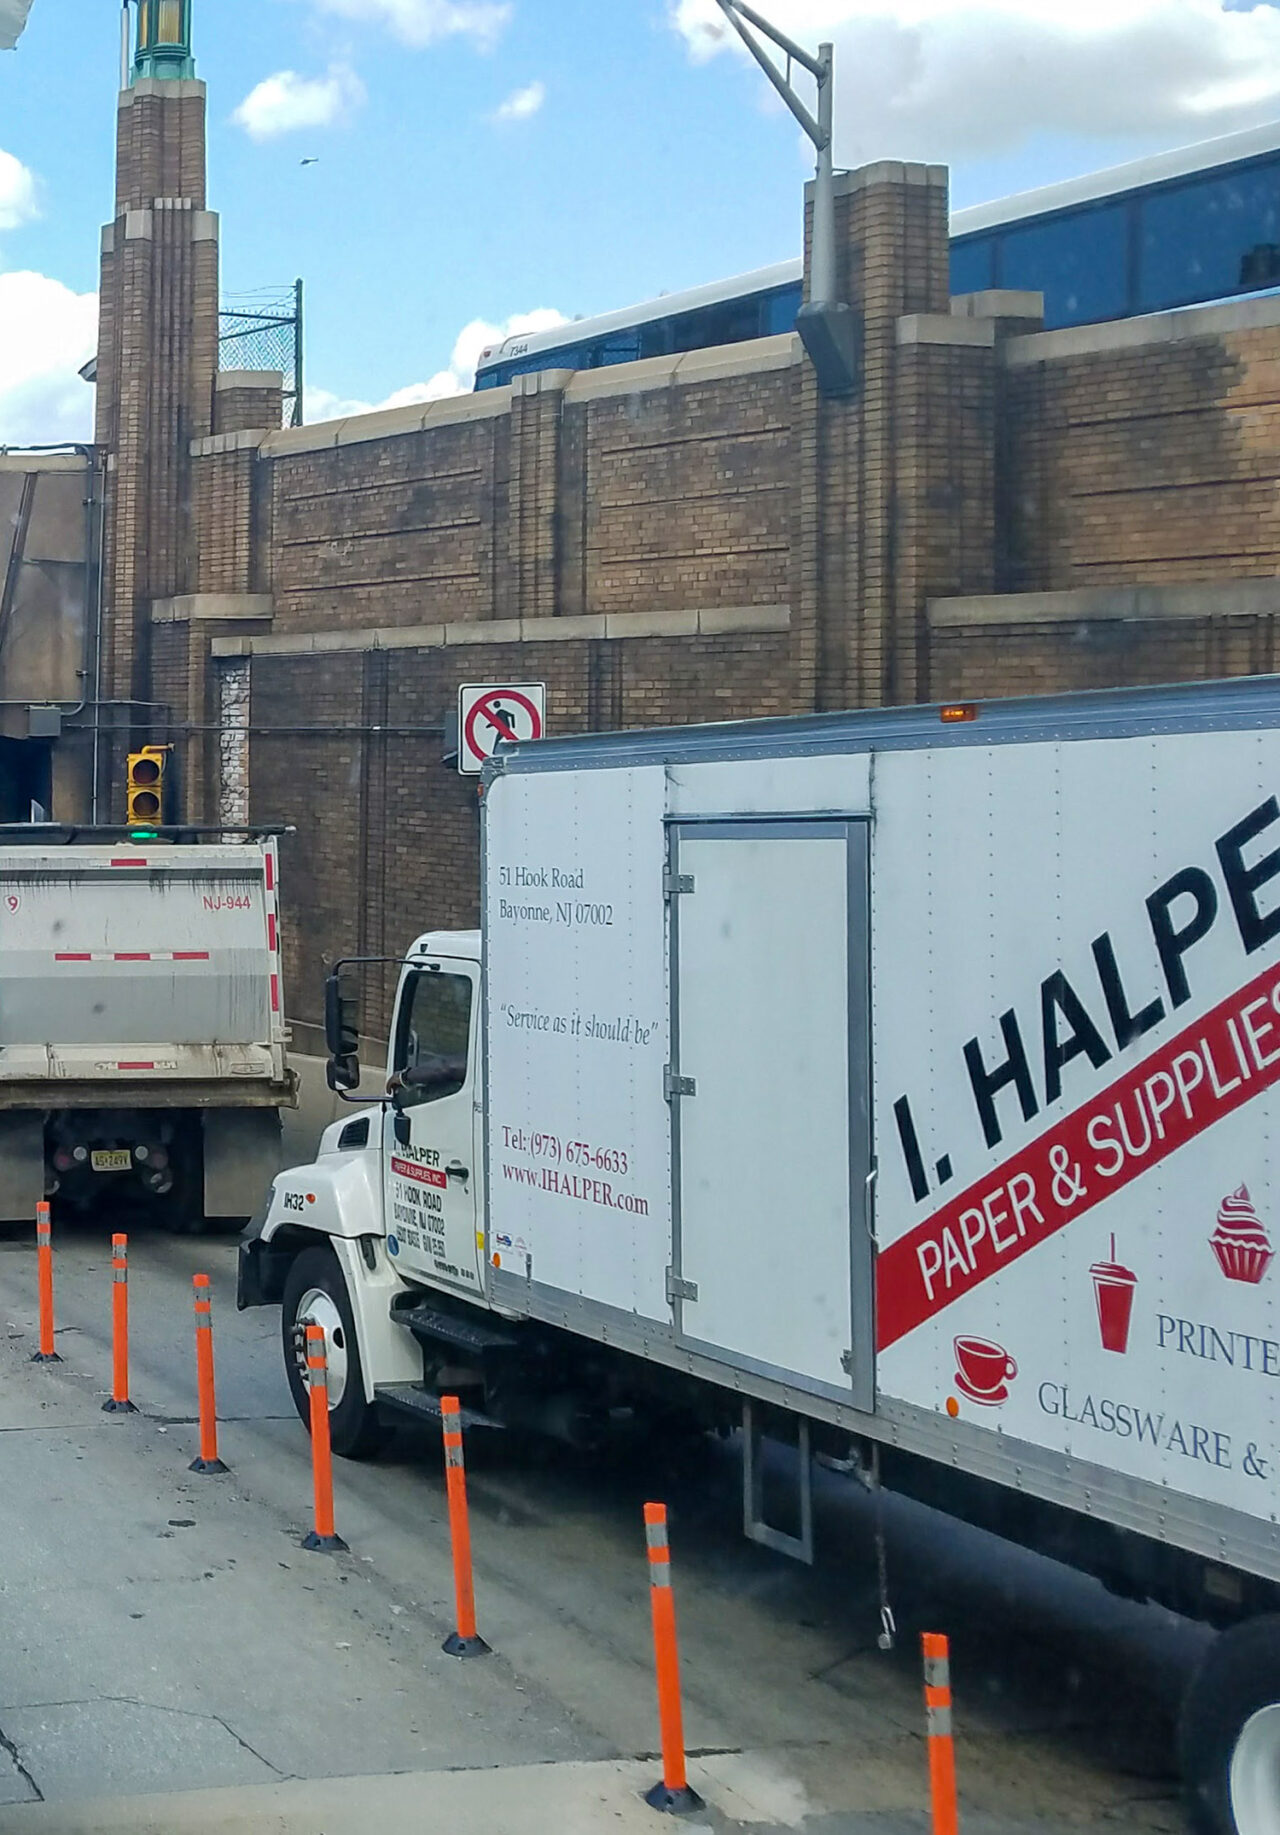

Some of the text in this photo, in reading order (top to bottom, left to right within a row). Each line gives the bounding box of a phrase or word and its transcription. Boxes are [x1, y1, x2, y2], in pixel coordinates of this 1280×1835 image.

[510, 343, 529, 357] 7344
[499, 866, 585, 890] 51 Hook Road
[7, 895, 19, 912] 9
[203, 895, 252, 910] NJ-944
[499, 899, 614, 928] Bayonne, NJ 07002
[893, 794, 1280, 1204] I. HALPE
[553, 1016, 567, 1034] as
[570, 1011, 582, 1036] it
[584, 1013, 631, 1042] should
[502, 1125, 628, 1176] Tel: (973) 675-6633
[916, 983, 1280, 1301] PAPER & SUPPLIE
[502, 1164, 650, 1216] www.IHALPER.com
[1038, 1381, 1269, 1480] GLASSWARE &
